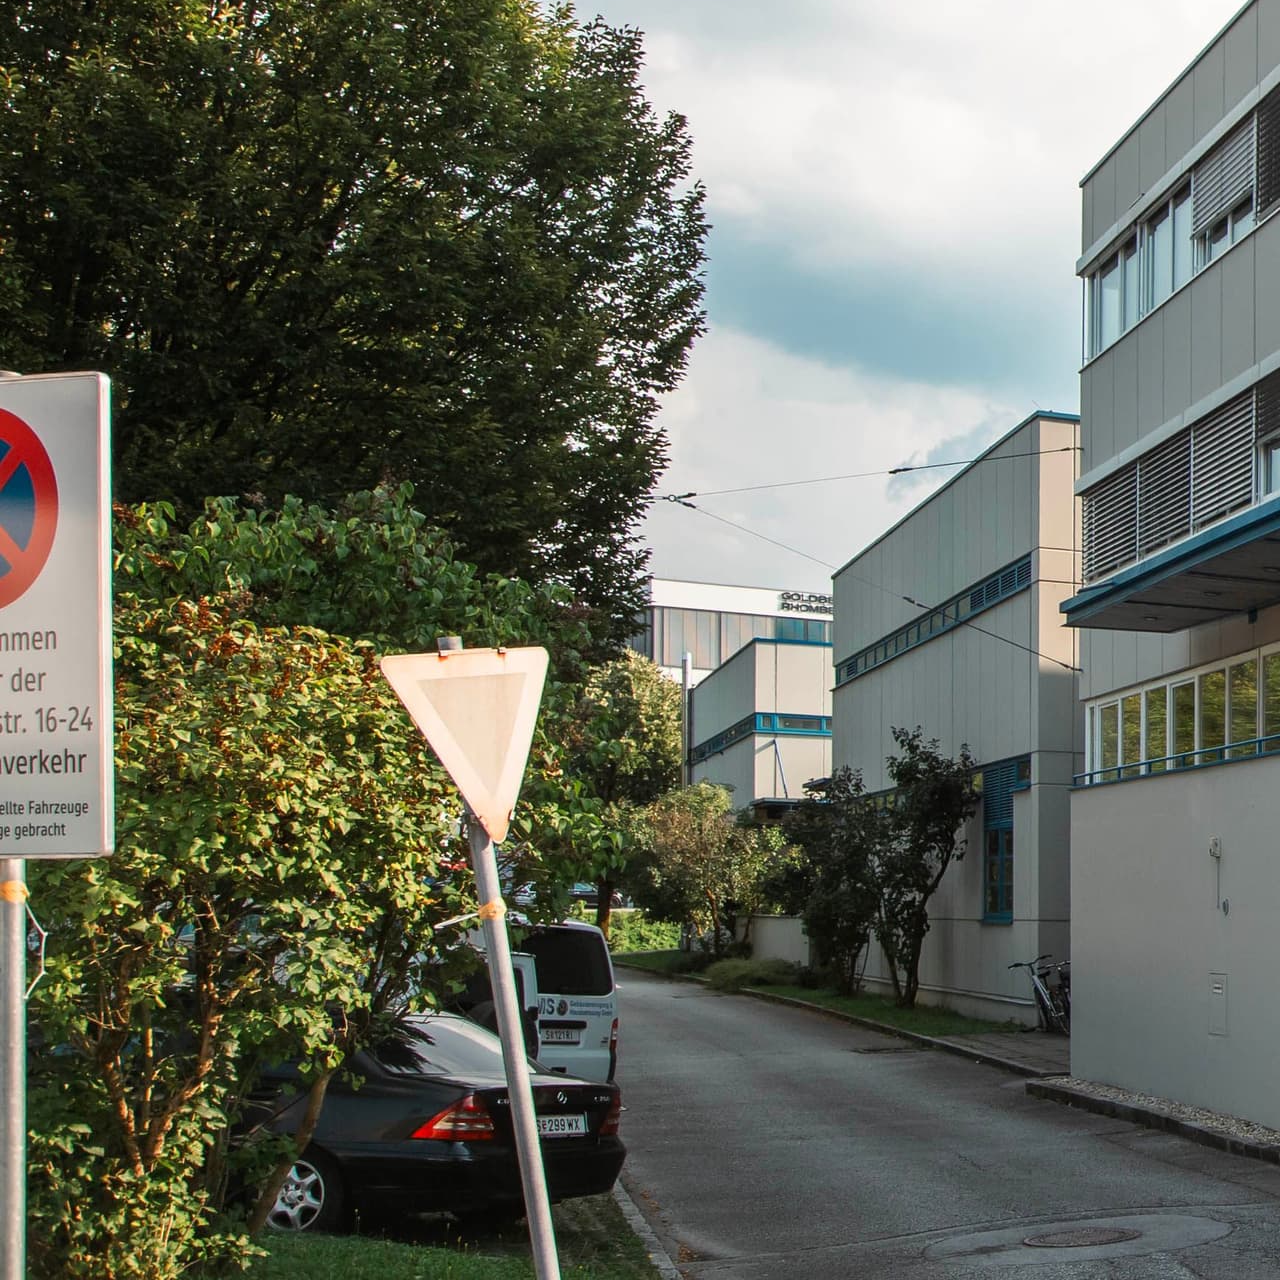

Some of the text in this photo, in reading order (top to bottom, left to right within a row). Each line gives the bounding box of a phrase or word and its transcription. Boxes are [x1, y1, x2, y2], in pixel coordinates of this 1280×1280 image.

[10, 666, 47, 692] der
[34, 705, 93, 733] 16-24
[0, 747, 87, 774] verkehr
[28, 800, 89, 817] Fahrzeuge
[14, 821, 67, 840] gebracht
[549, 1119, 565, 1132] 299
